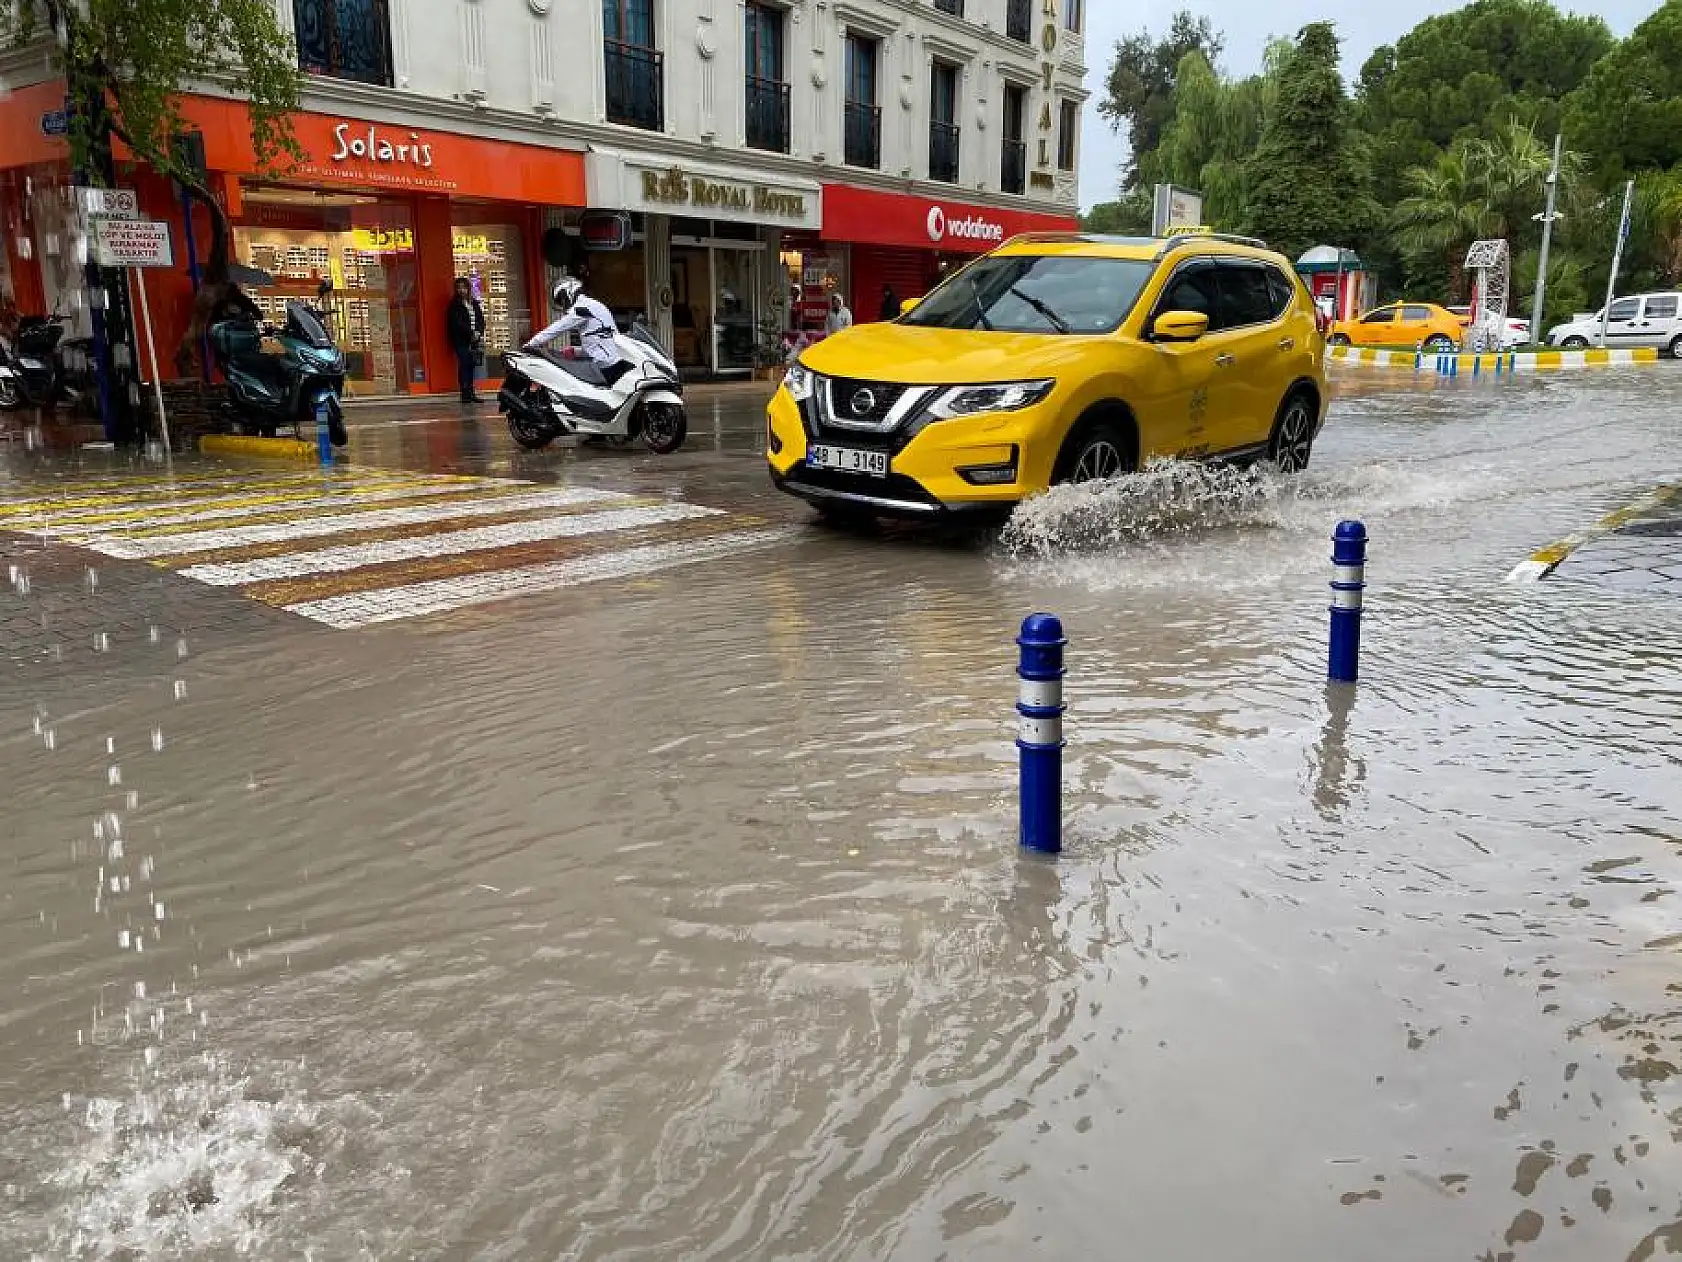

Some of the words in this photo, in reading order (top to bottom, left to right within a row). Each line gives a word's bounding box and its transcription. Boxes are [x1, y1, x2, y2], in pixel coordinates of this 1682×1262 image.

[331, 121, 432, 167] Solaris
[691, 178, 751, 209] ROYAL
[947, 214, 1003, 241] vodafone
[837, 450, 844, 466] T
[852, 452, 884, 471] 3149
